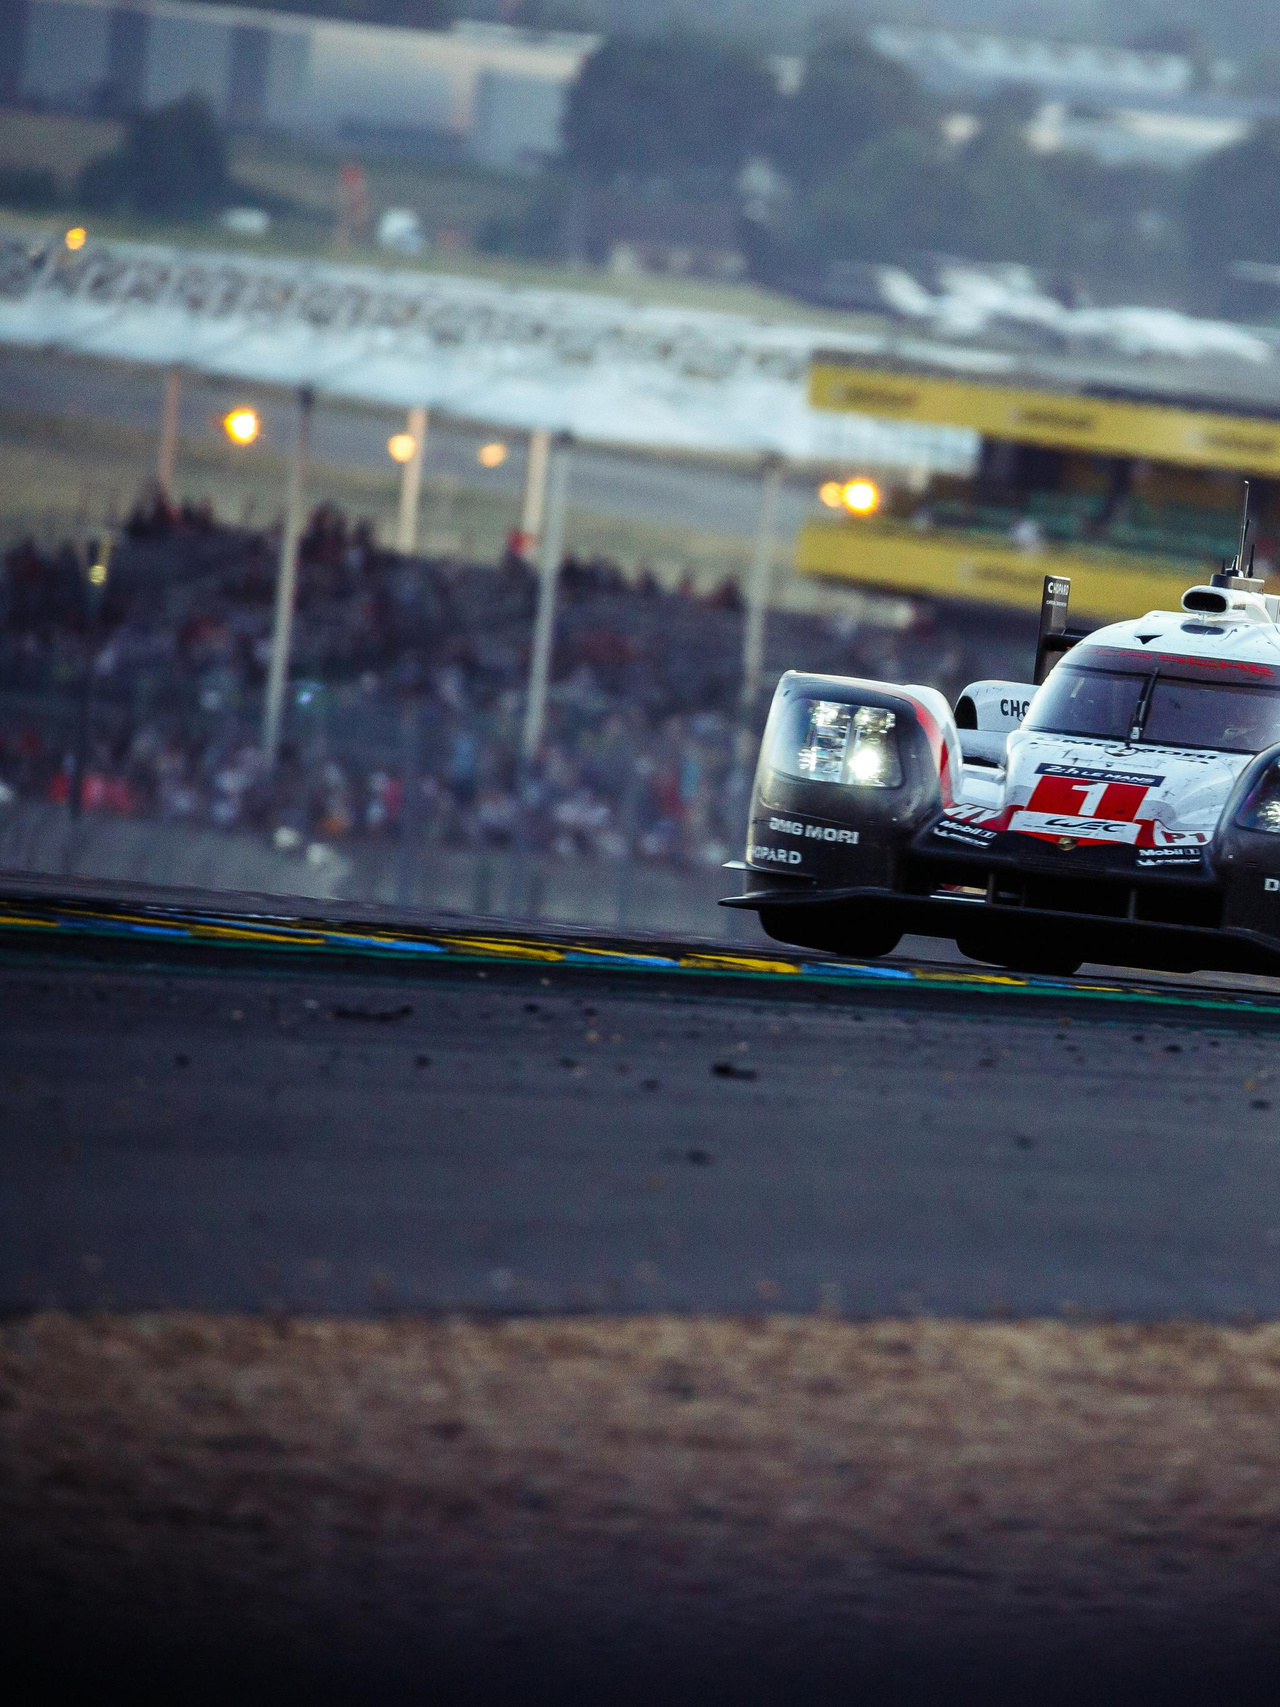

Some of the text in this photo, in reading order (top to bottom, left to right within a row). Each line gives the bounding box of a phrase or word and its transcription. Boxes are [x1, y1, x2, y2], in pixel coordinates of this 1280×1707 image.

[1083, 648, 1276, 678] ORSCHE
[1104, 773, 1155, 784] MANS
[1071, 783, 1110, 817] 1
[939, 820, 982, 836] Mobil
[1044, 818, 1128, 833] WEC
[804, 824, 860, 845] MORI
[1160, 830, 1208, 844] P1
[1139, 848, 1183, 857] Mobil
